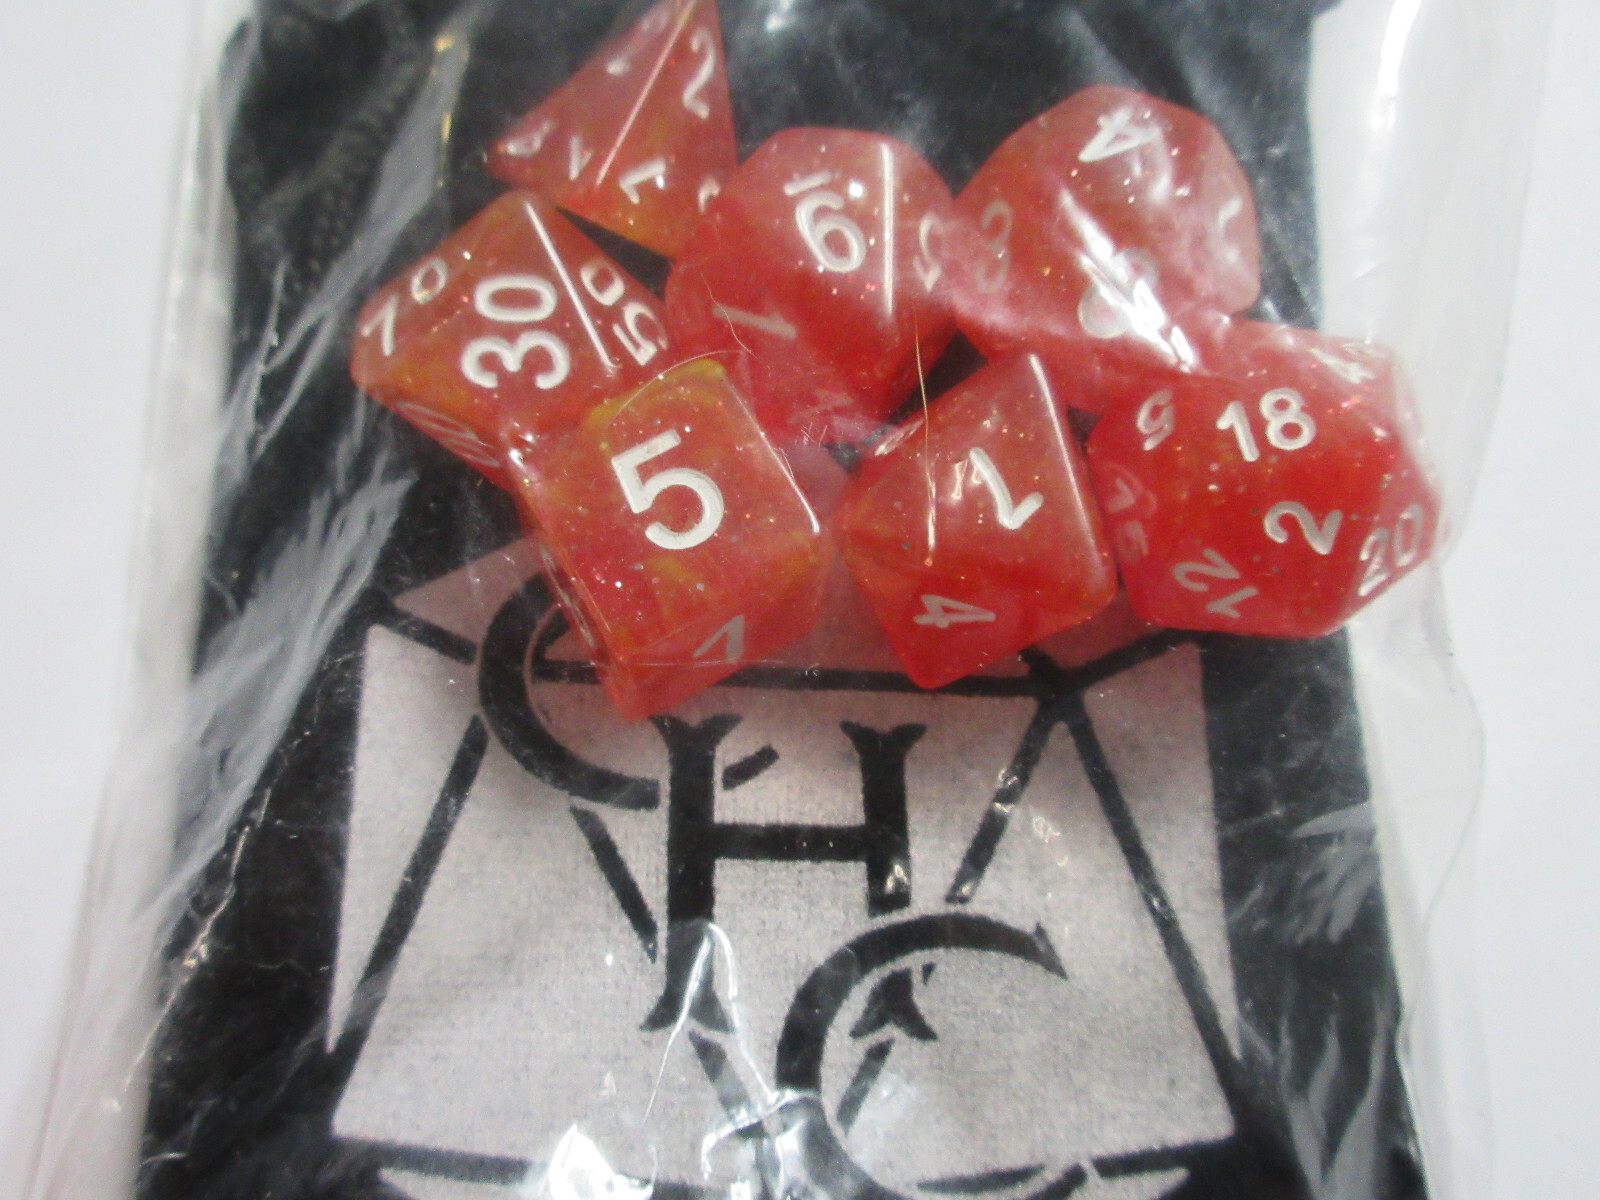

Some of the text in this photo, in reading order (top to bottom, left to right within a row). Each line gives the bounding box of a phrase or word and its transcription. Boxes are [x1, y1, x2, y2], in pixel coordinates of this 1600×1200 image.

[682, 26, 717, 120] 2
[460, 273, 571, 390] 30
[1216, 387, 1316, 462] 18
[611, 428, 725, 550] 5
[1264, 501, 1342, 556] 2
[1358, 504, 1424, 597] 20
[913, 594, 997, 628] 4
